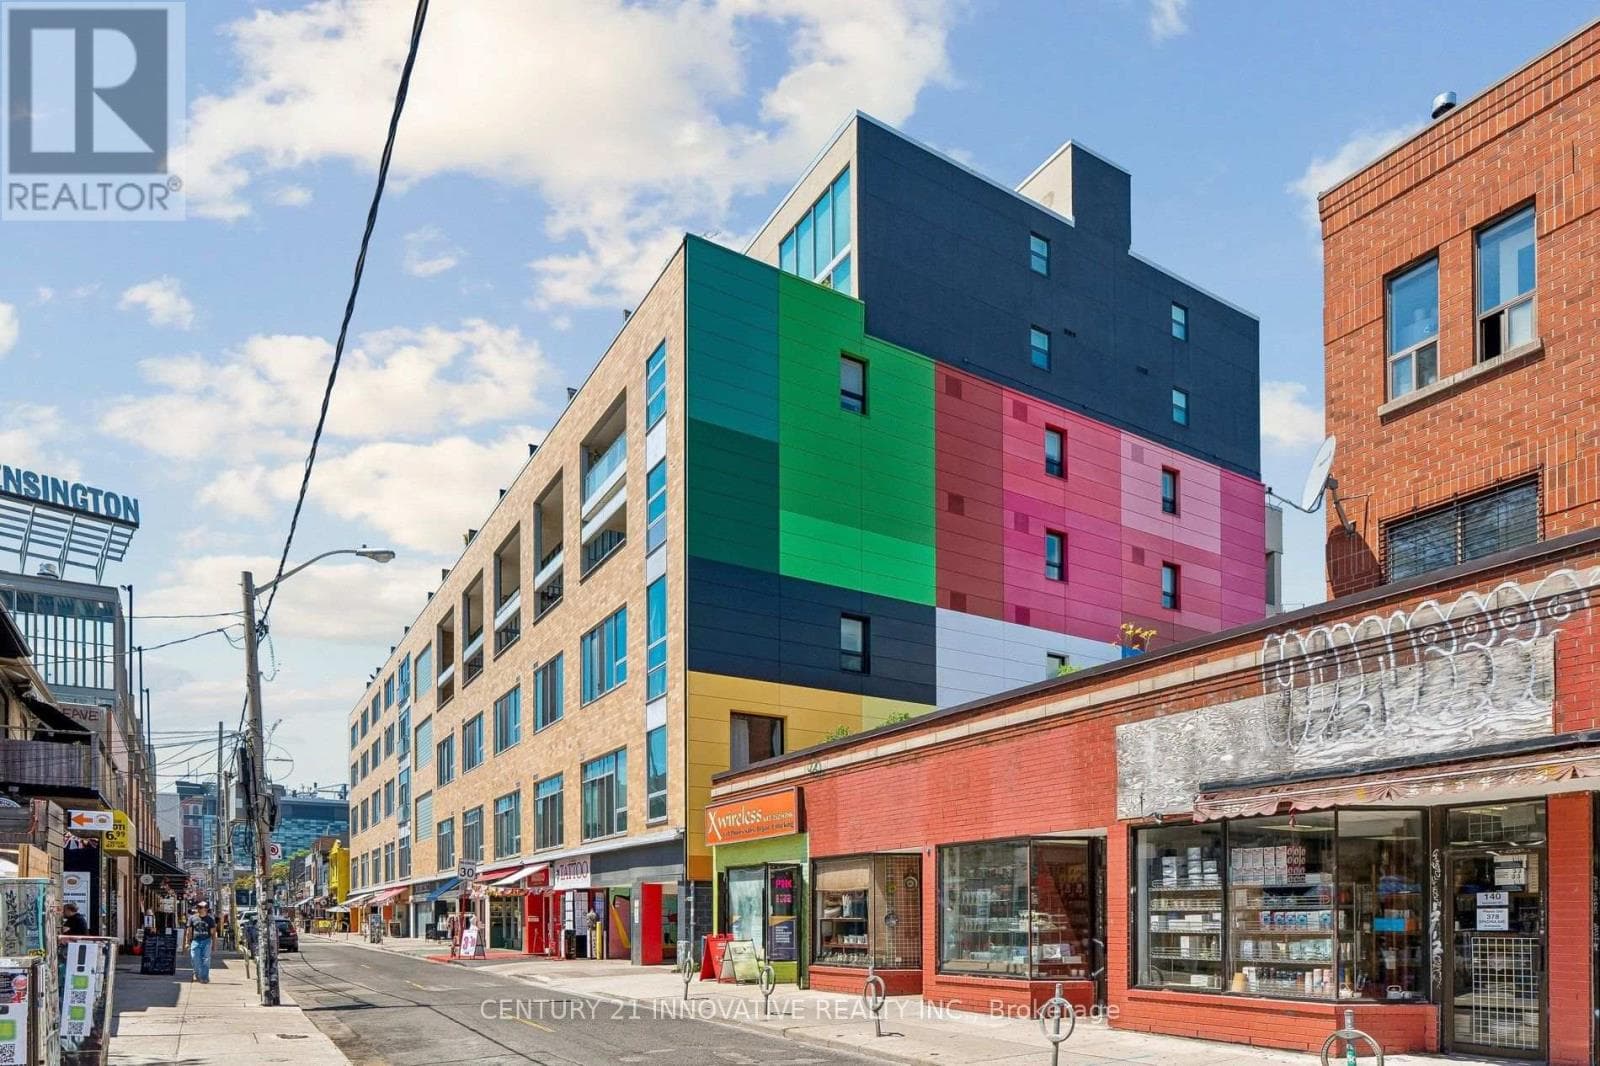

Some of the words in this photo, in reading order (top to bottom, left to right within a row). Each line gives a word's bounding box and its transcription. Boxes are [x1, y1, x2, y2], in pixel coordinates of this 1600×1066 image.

[0, 463, 140, 524] NSINGTON
[459, 867, 474, 878] 30
[559, 860, 589, 880] TATTOO
